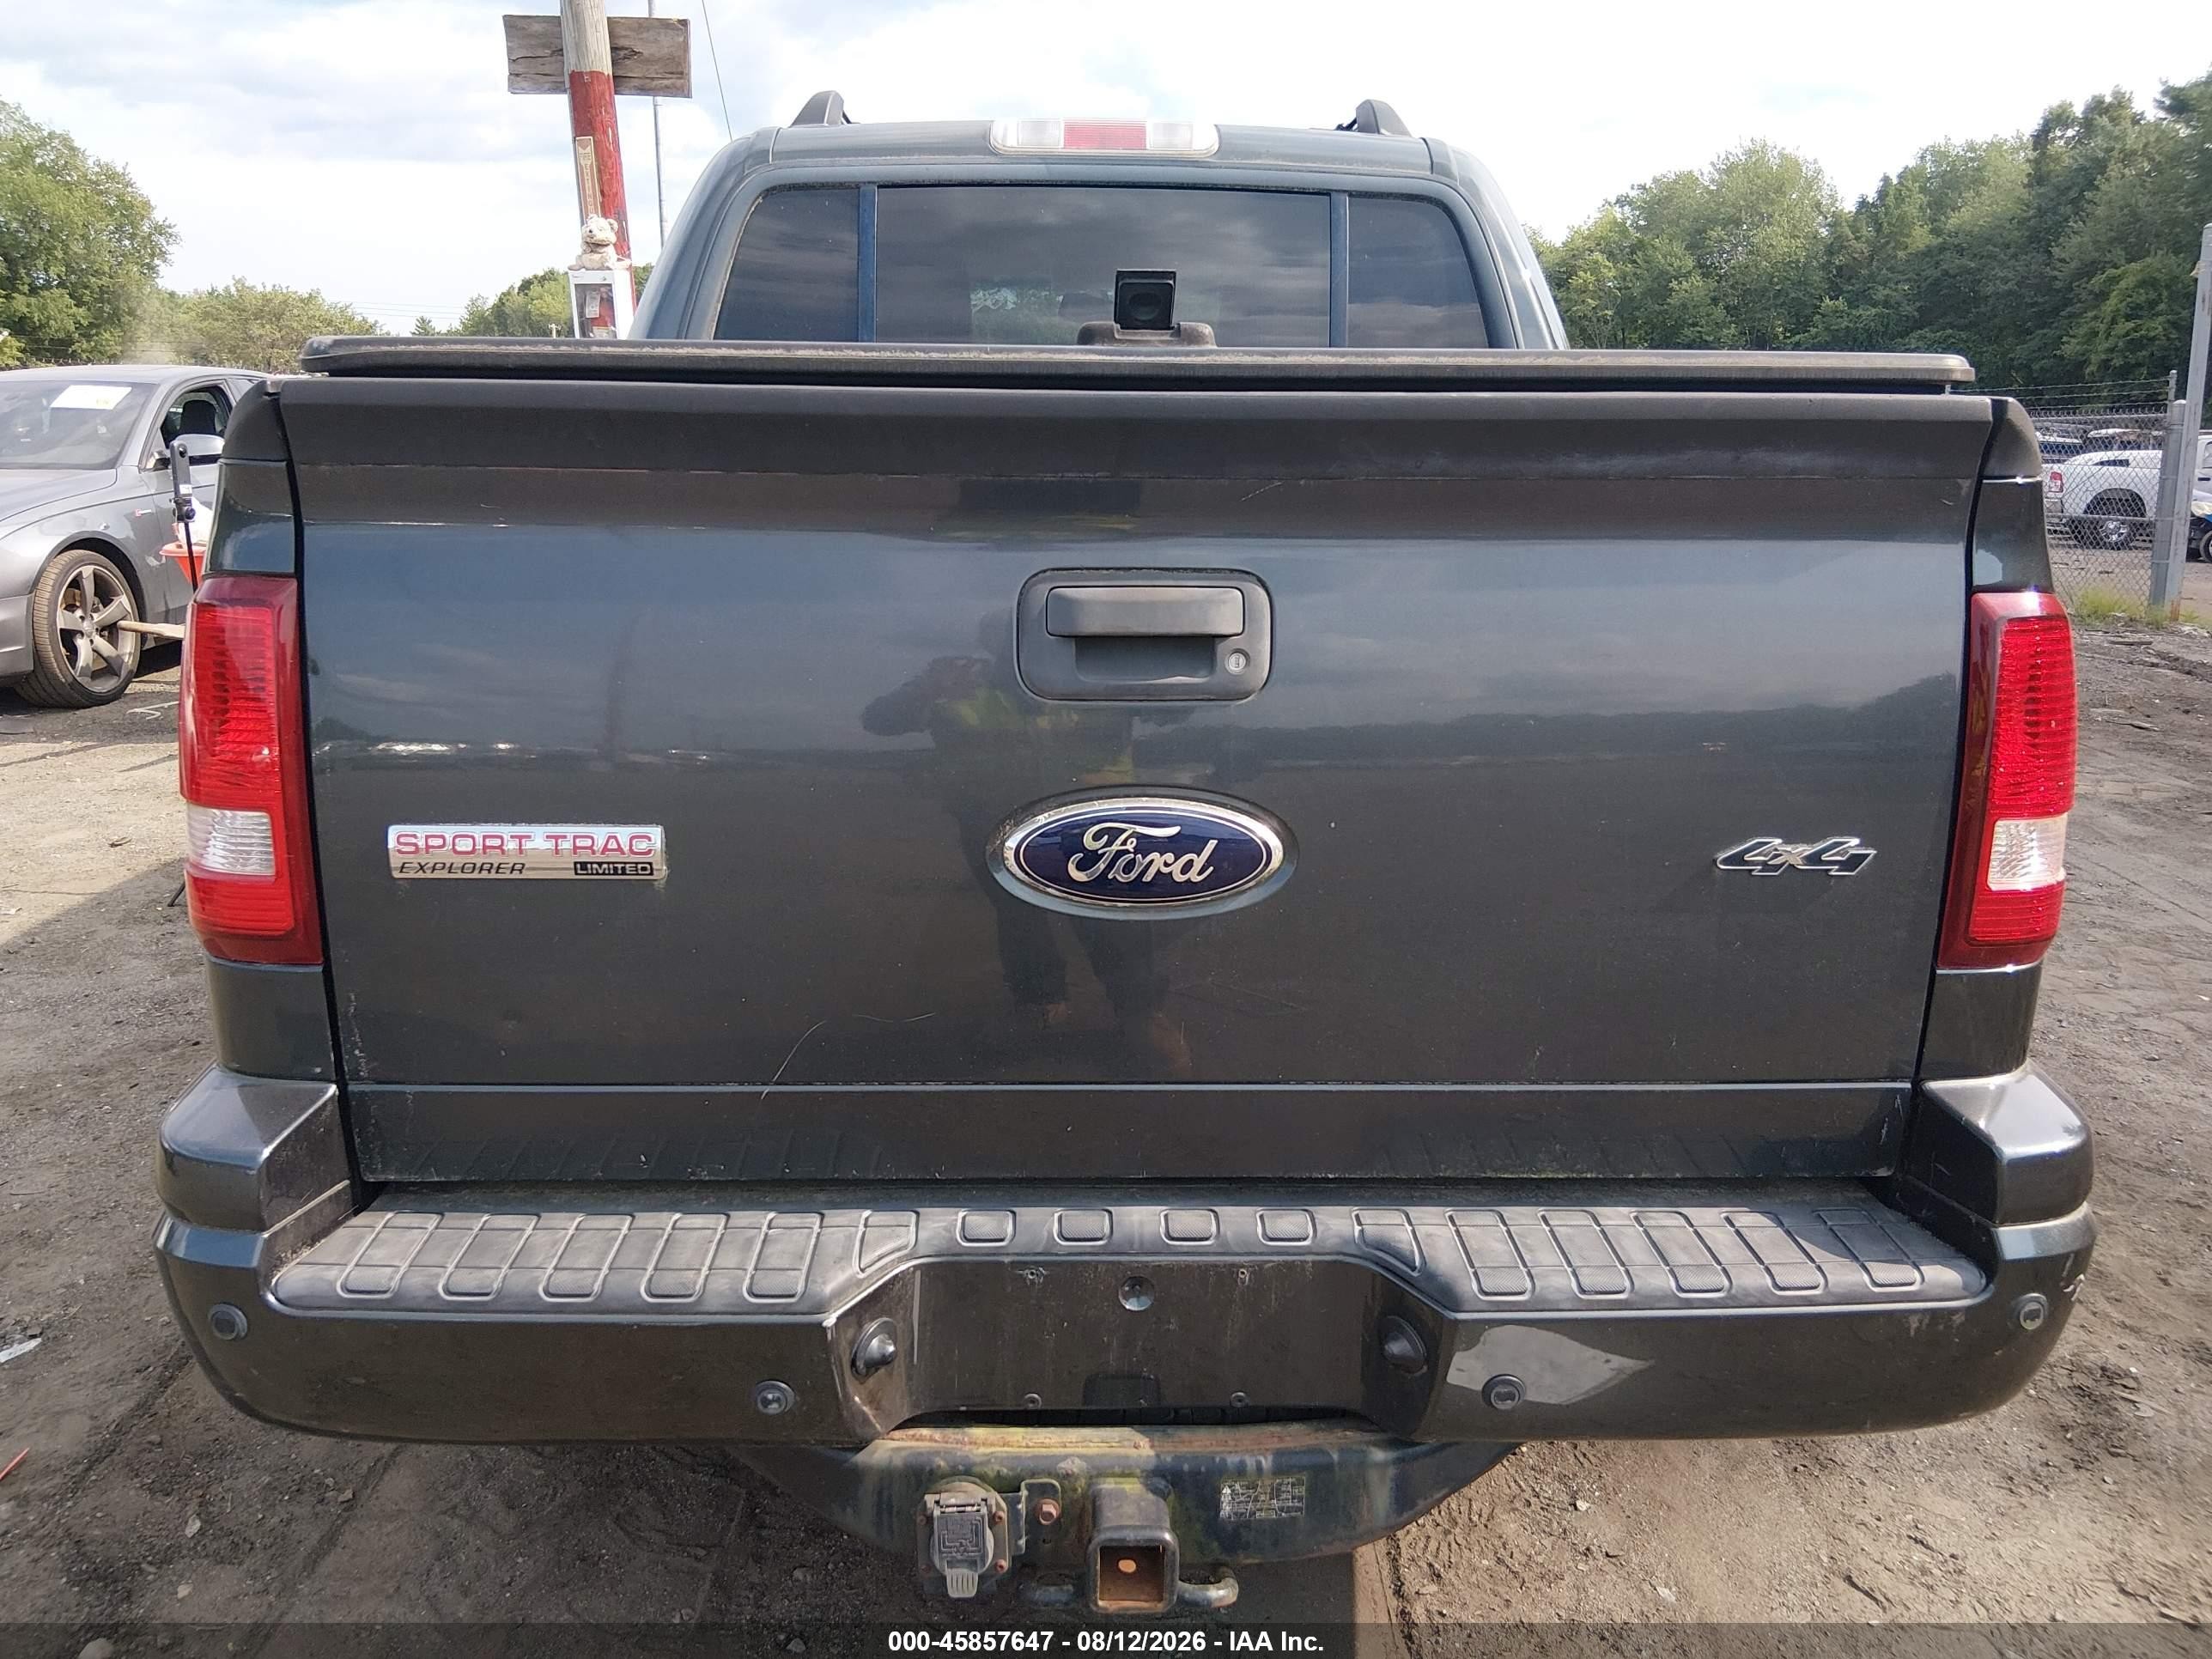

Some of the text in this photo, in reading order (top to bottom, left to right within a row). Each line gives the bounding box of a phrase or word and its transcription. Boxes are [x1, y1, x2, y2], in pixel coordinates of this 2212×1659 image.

[584, 164, 594, 214] EXTINGU
[396, 833, 654, 856] SPORT TRAC
[1067, 822, 1218, 883] Ford
[398, 861, 526, 874] EXPLORER
[576, 863, 652, 874] LIMITED
